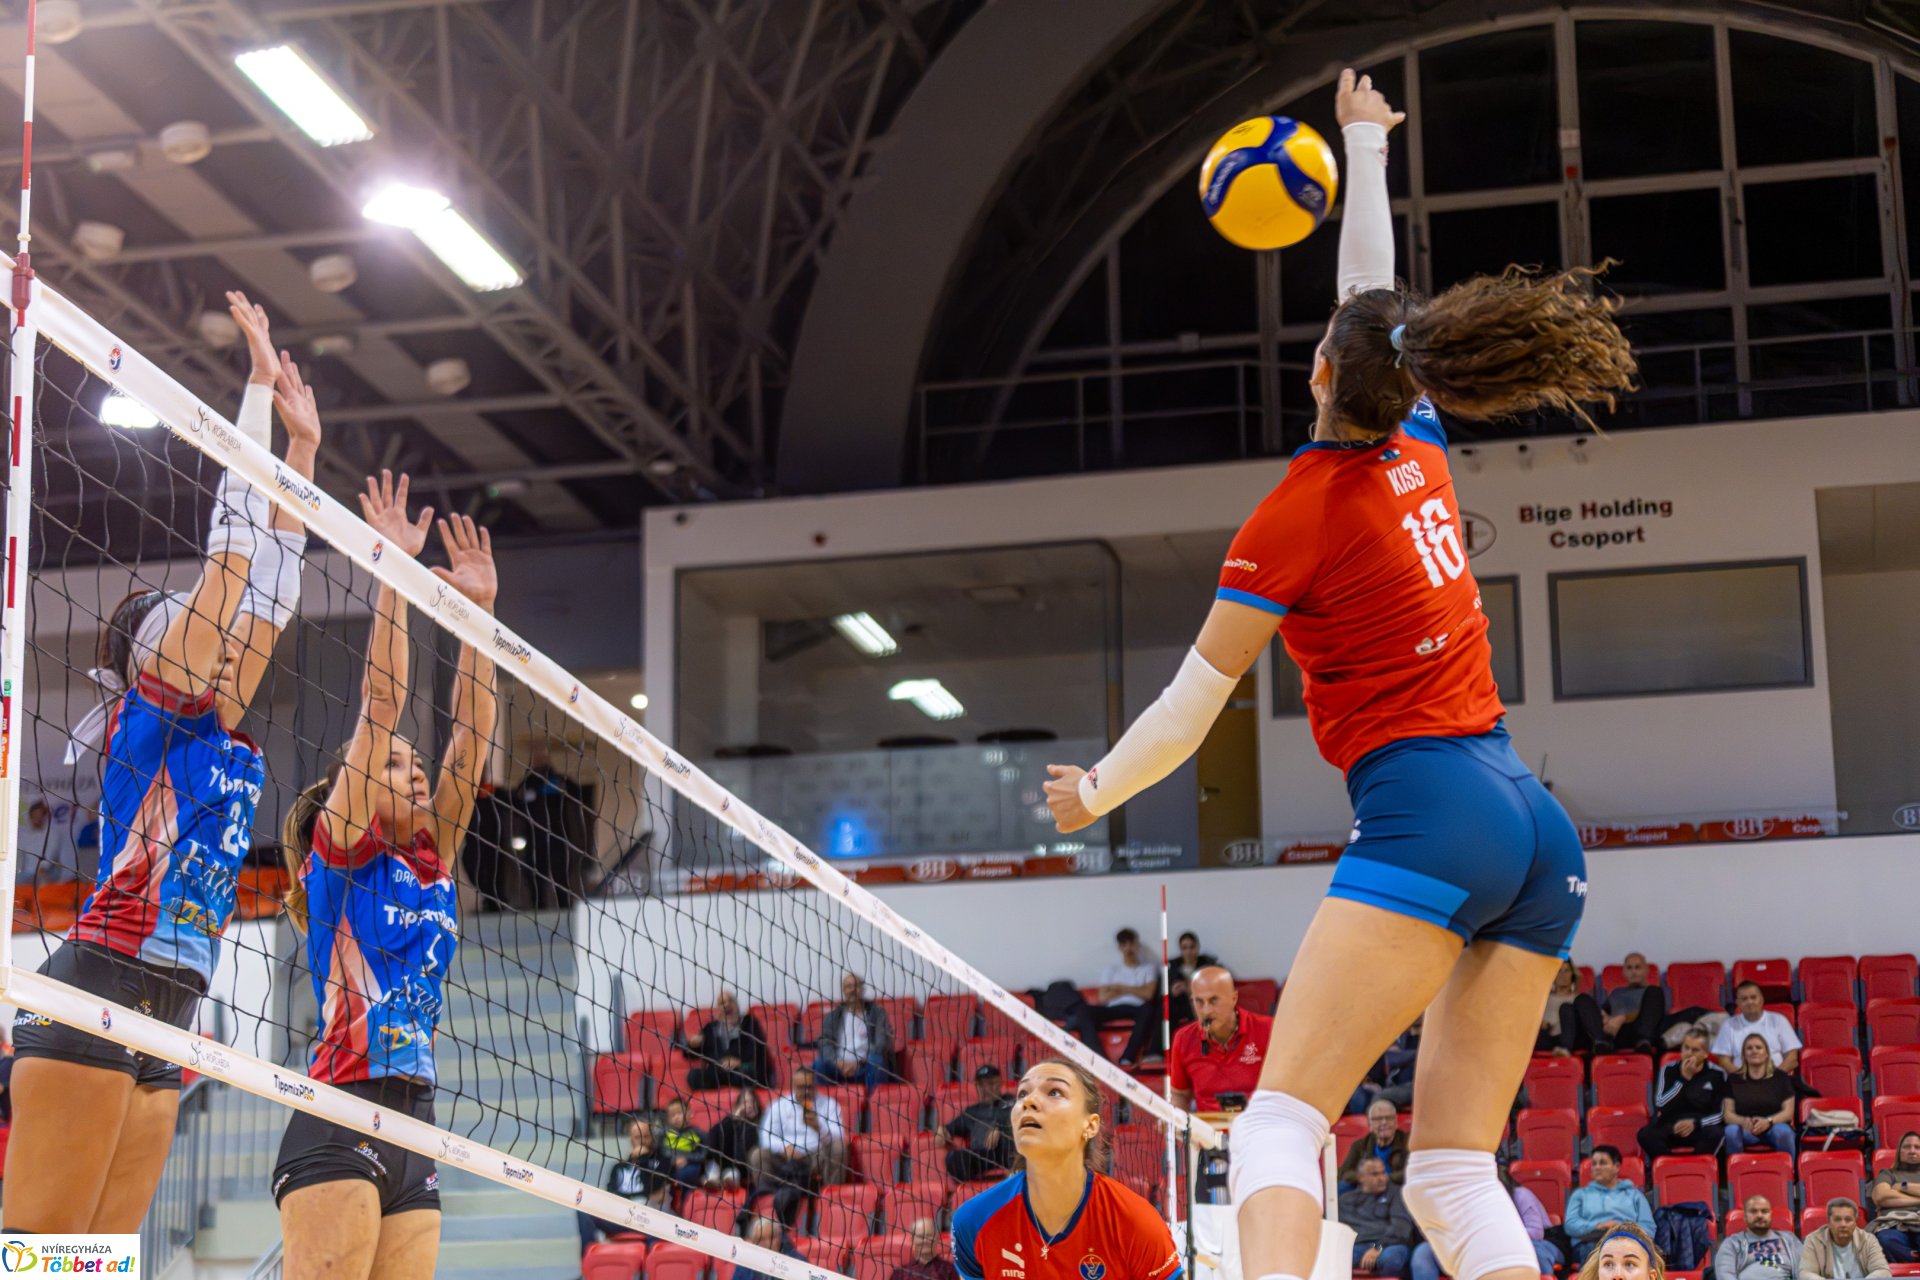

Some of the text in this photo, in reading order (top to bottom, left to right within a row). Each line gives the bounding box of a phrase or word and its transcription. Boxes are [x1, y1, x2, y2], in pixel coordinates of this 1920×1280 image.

[274, 463, 321, 512] TippmixPRO
[1386, 459, 1426, 497] KISS
[1520, 498, 1673, 524] Bige Holding
[1402, 497, 1466, 590] 16
[1549, 526, 1646, 549] Csoport
[273, 1073, 316, 1102] TippmixPRO
[1001, 1269, 1025, 1280] nine
